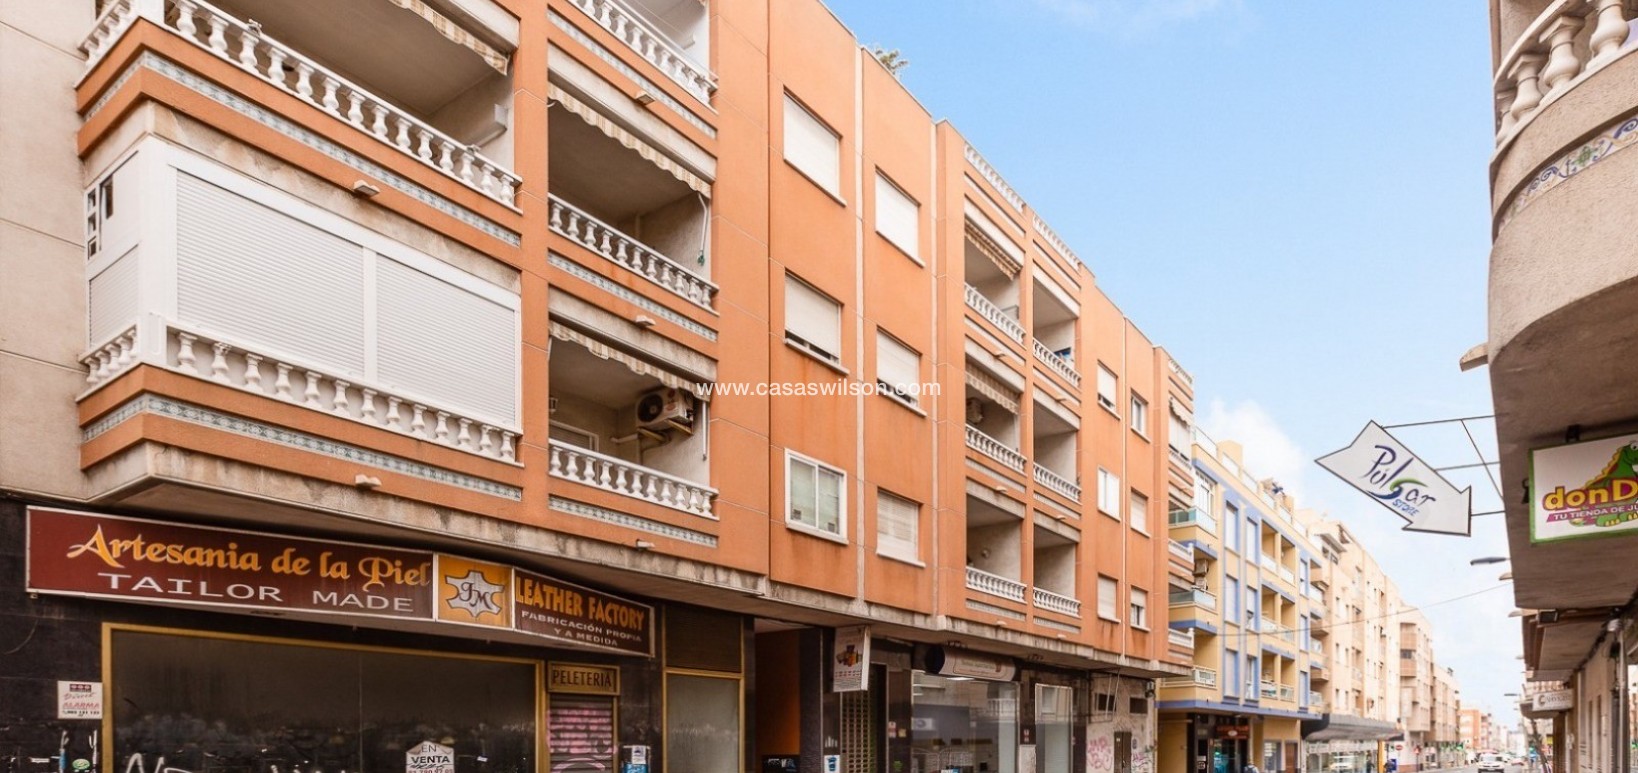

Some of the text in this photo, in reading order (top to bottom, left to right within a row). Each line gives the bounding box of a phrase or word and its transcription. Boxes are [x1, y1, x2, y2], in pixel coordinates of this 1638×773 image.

[1392, 499, 1420, 517] STORE
[1570, 508, 1608, 518] TIENDA
[1610, 506, 1625, 514] DE
[66, 524, 432, 592] Artesania de la Piel
[97, 572, 414, 613] TAILOR MADE
[515, 576, 645, 631] LEATHER FACTORY
[521, 610, 642, 642] FABRICACIÓN PROPIA
[554, 627, 618, 647] Y A MEDIDA
[421, 744, 437, 753] EN
[411, 755, 450, 764] VENTA
